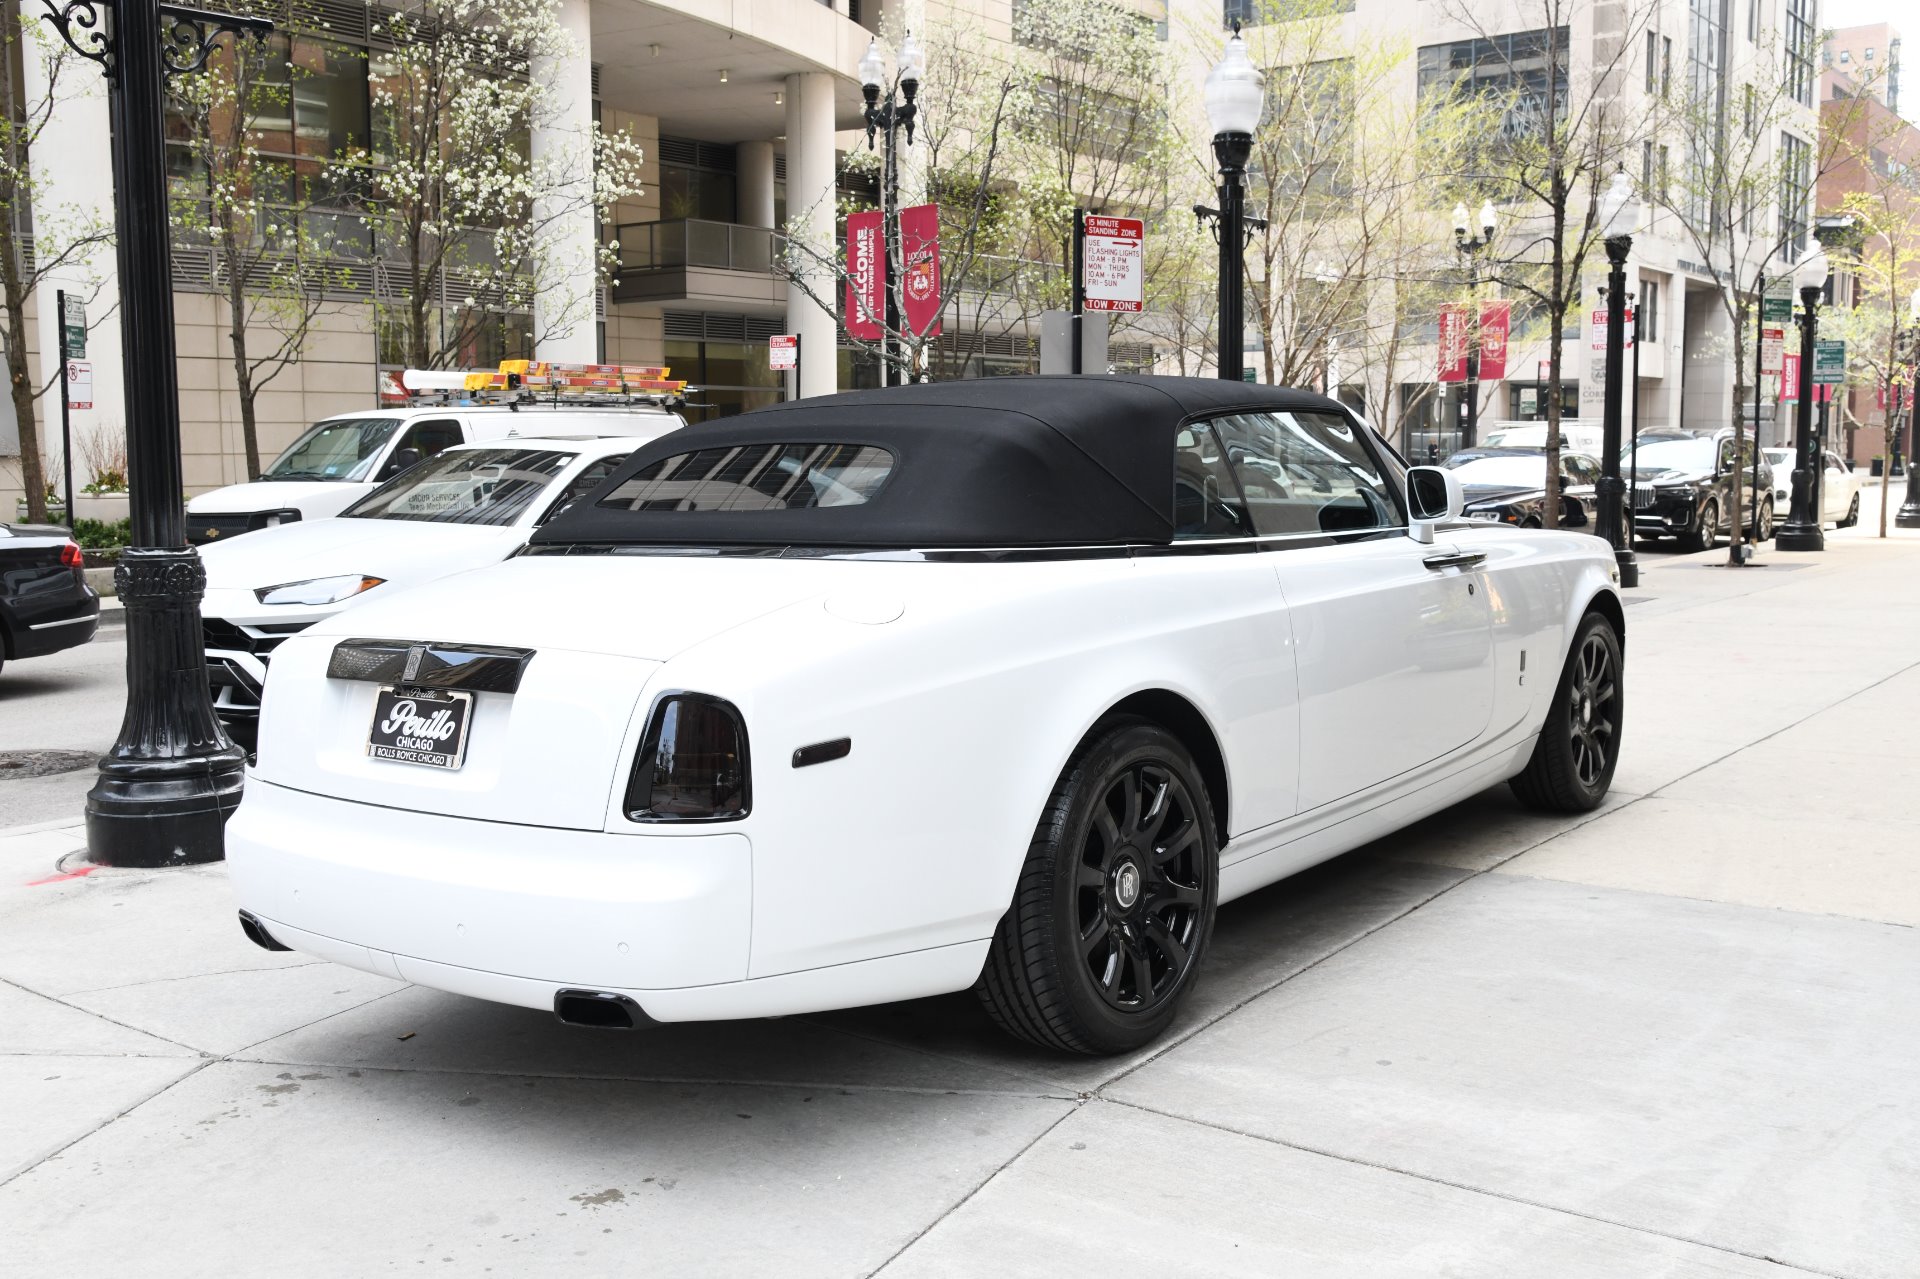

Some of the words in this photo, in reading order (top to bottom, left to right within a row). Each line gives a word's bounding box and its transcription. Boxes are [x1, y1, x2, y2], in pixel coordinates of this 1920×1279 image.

[1097, 220, 1119, 228] MINUTE
[1088, 227, 1118, 236] STANDING
[1088, 248, 1118, 256] FLASHING
[856, 229, 868, 324] WELCOME
[1088, 300, 1108, 309] TOW
[1113, 301, 1137, 310] ZONE
[408, 688, 437, 698] Perillo
[381, 700, 456, 741] Perillo
[396, 736, 433, 751] CHICAGO
[377, 748, 395, 758] ROLLS
[397, 751, 417, 760] ROYCE
[417, 754, 444, 764] CHICAGO
